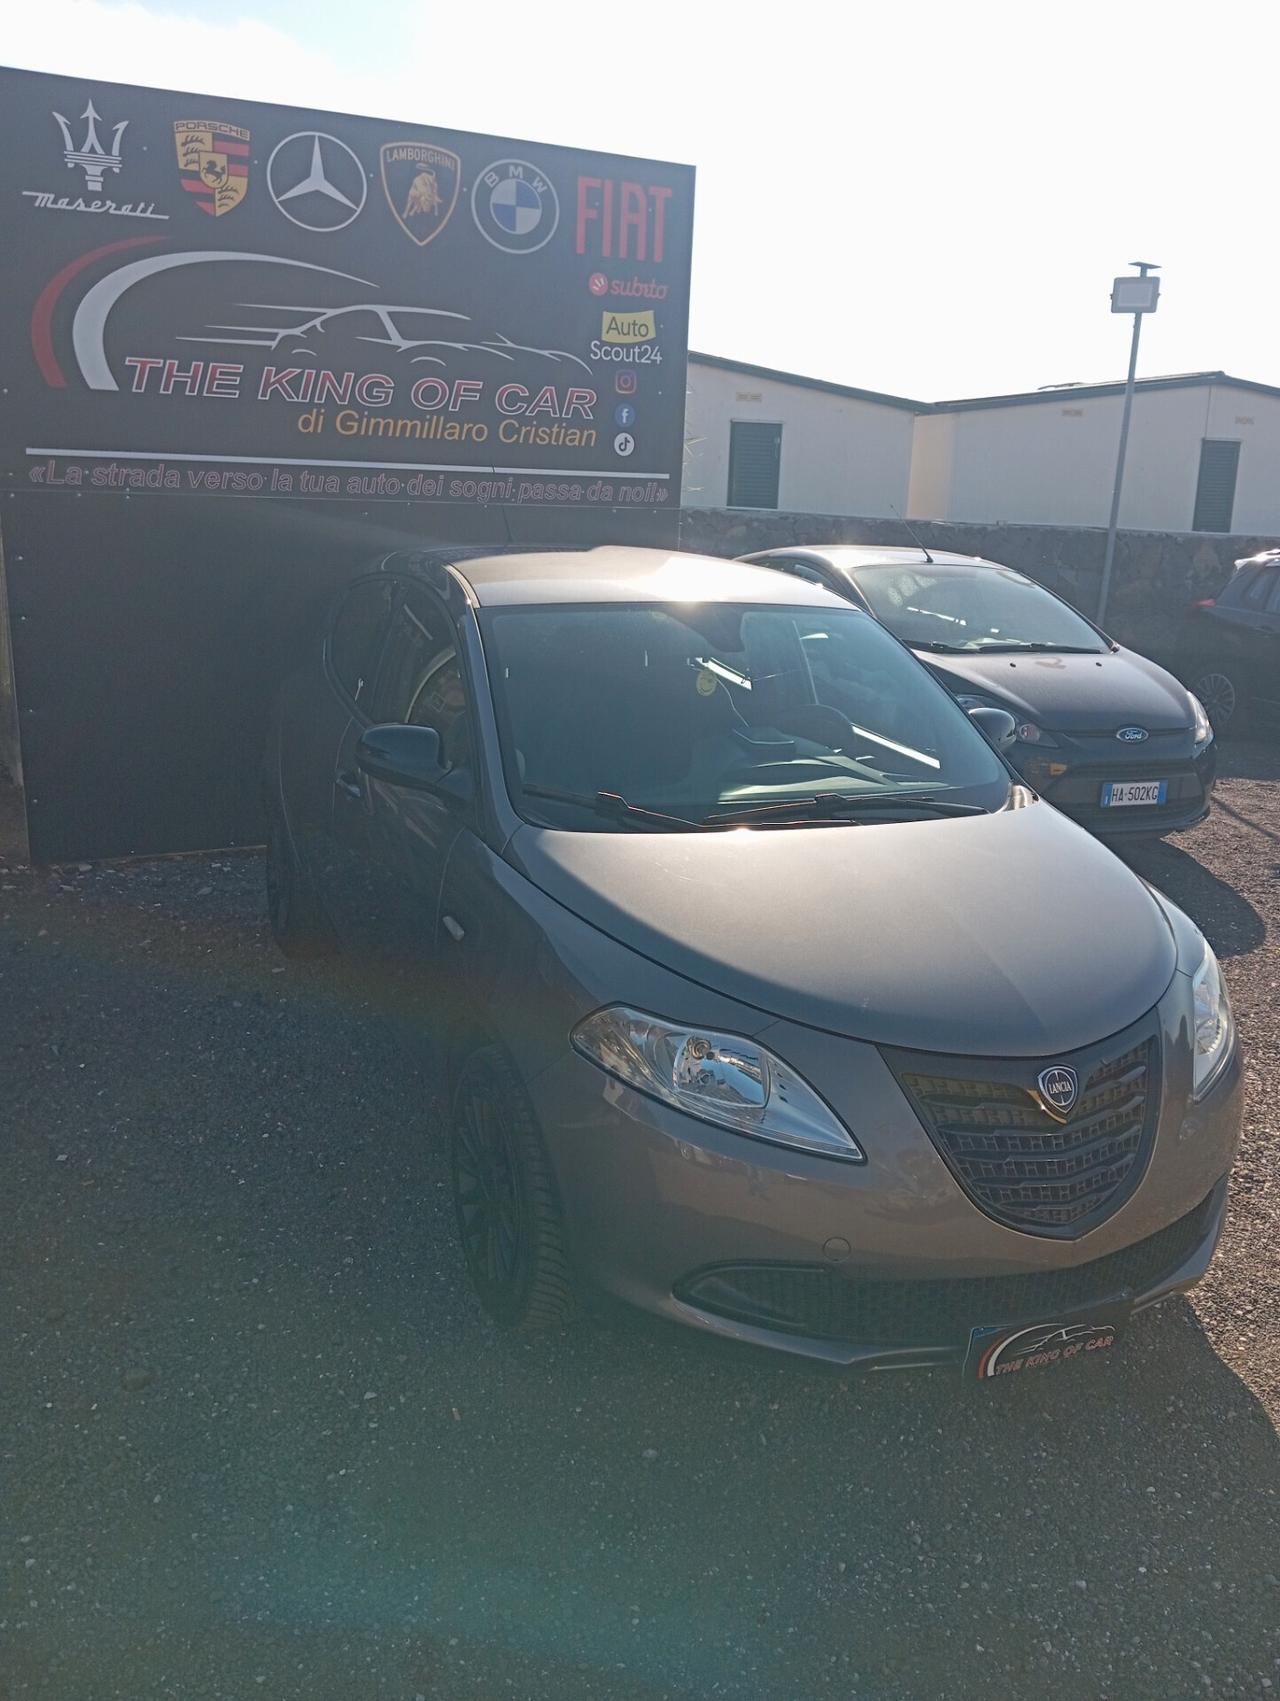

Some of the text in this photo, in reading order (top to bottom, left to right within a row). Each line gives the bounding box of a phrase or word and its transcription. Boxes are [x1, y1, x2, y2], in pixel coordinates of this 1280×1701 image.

[175, 121, 250, 139] PORSCHE
[386, 148, 456, 170] LAMBORGHINI
[484, 166, 548, 193] BMW
[575, 176, 673, 263] FIAT
[610, 276, 669, 300] subito
[606, 316, 649, 337] Auto
[590, 340, 662, 365] Scout24
[125, 357, 597, 419] THE KING OF CAR
[297, 408, 597, 447] di Gimmillaro Cristian
[91, 463, 180, 488] strada
[187, 469, 264, 491] verso
[270, 468, 293, 492] la
[300, 470, 340, 493] tua
[347, 473, 401, 495] auto
[406, 474, 445, 496] dei
[450, 477, 513, 502] sogni
[518, 482, 582, 504] passa
[586, 480, 613, 501] da
[1124, 730, 1143, 740] Ford
[1048, 1080, 1072, 1094] LANCIA
[1063, 1342, 1084, 1359] OF
[1085, 1335, 1114, 1351] CAR
